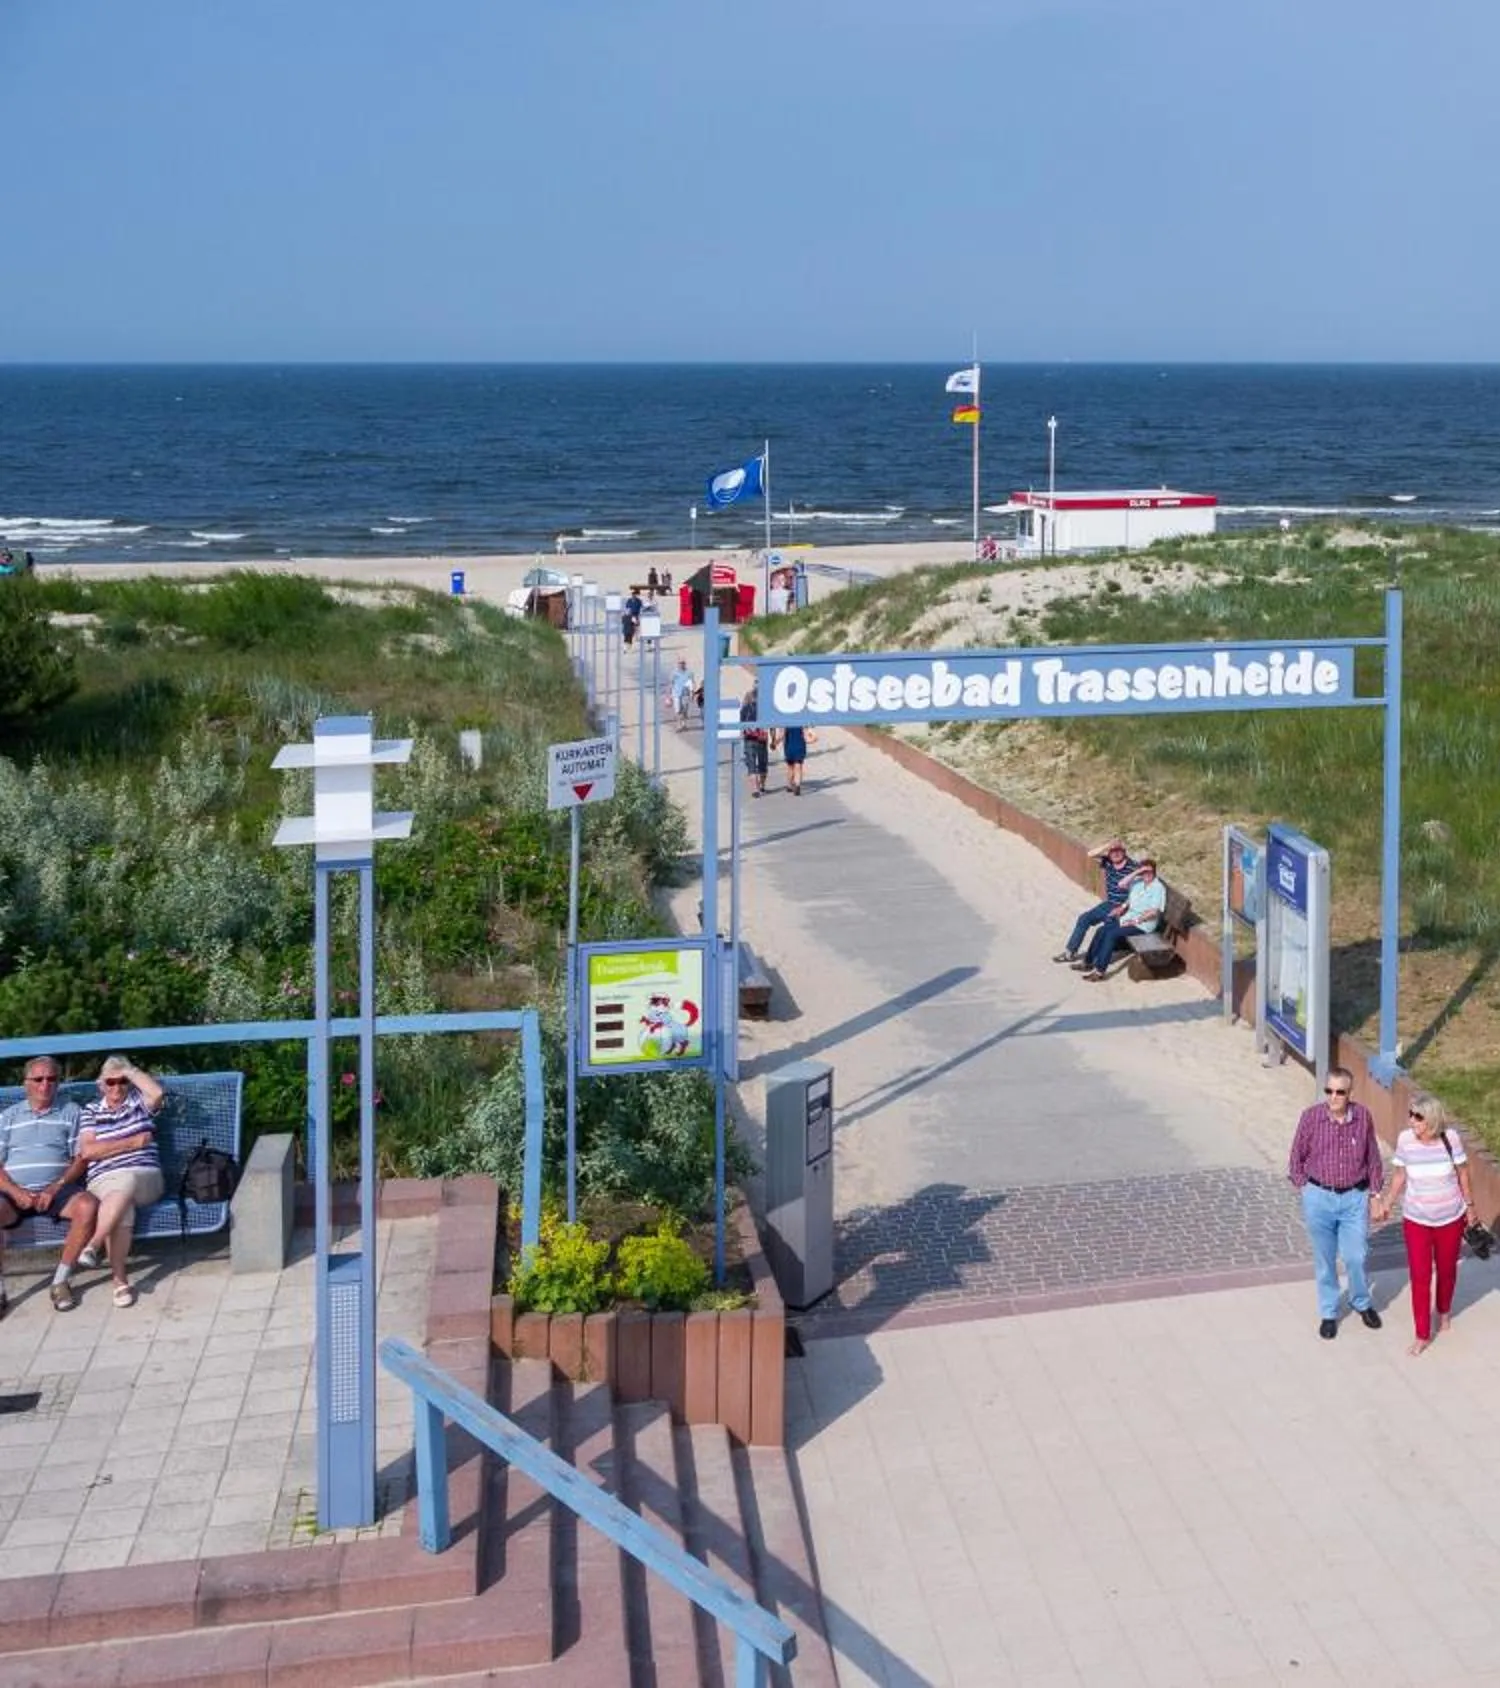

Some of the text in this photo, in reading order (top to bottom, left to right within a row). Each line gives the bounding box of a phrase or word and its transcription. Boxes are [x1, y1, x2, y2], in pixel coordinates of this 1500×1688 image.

[773, 651, 1339, 713] Ostseebad Trassenheide
[556, 743, 613, 761] KURKARTEN
[561, 758, 606, 775] AUTOMAT
